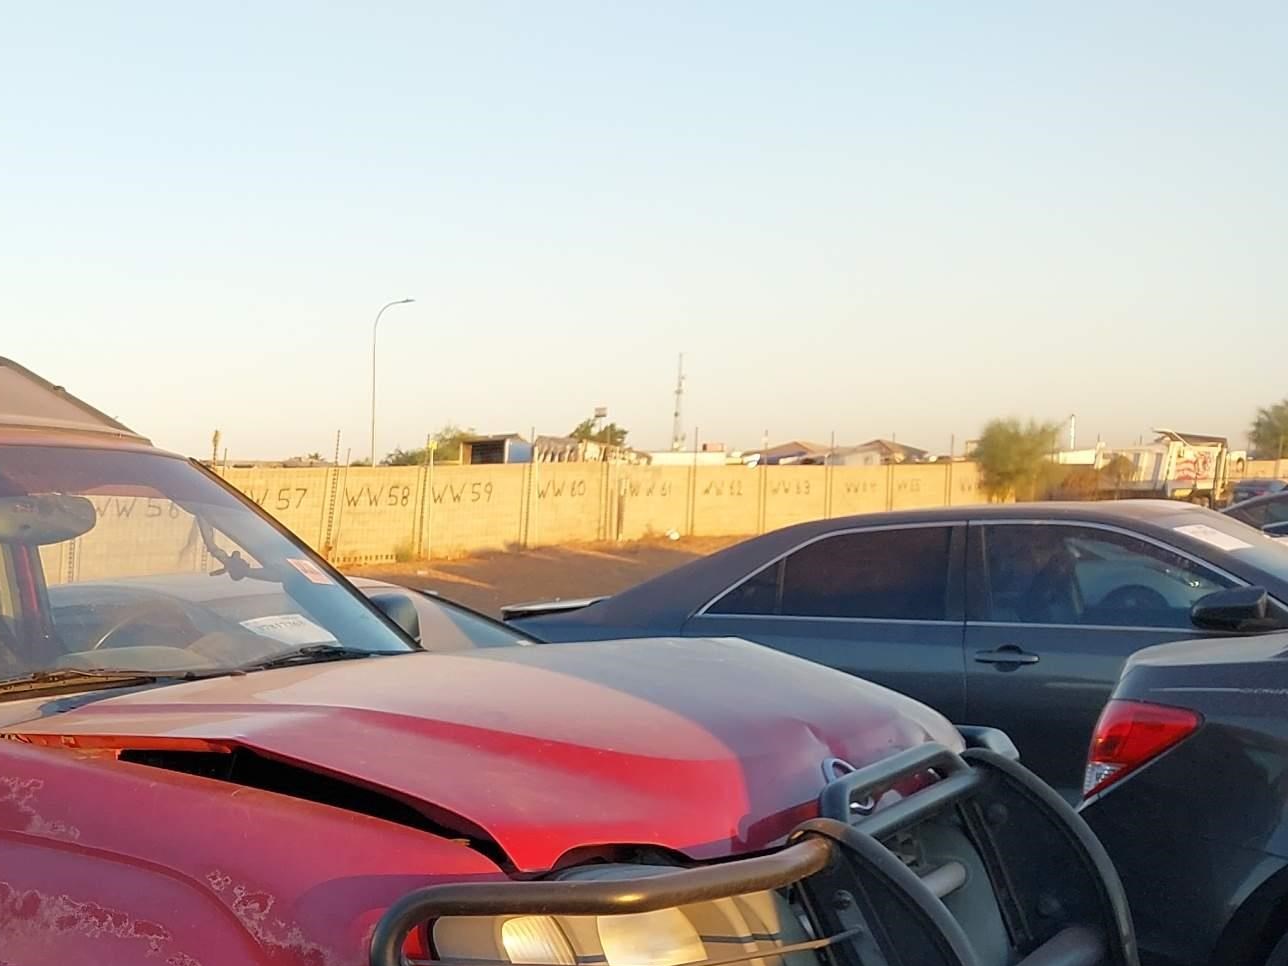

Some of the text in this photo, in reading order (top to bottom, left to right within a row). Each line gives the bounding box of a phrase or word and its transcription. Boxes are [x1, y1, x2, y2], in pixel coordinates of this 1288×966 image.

[275, 487, 308, 511] 57
[345, 485, 411, 508] WW 58
[431, 481, 494, 505] WW 59
[538, 479, 565, 499] WW
